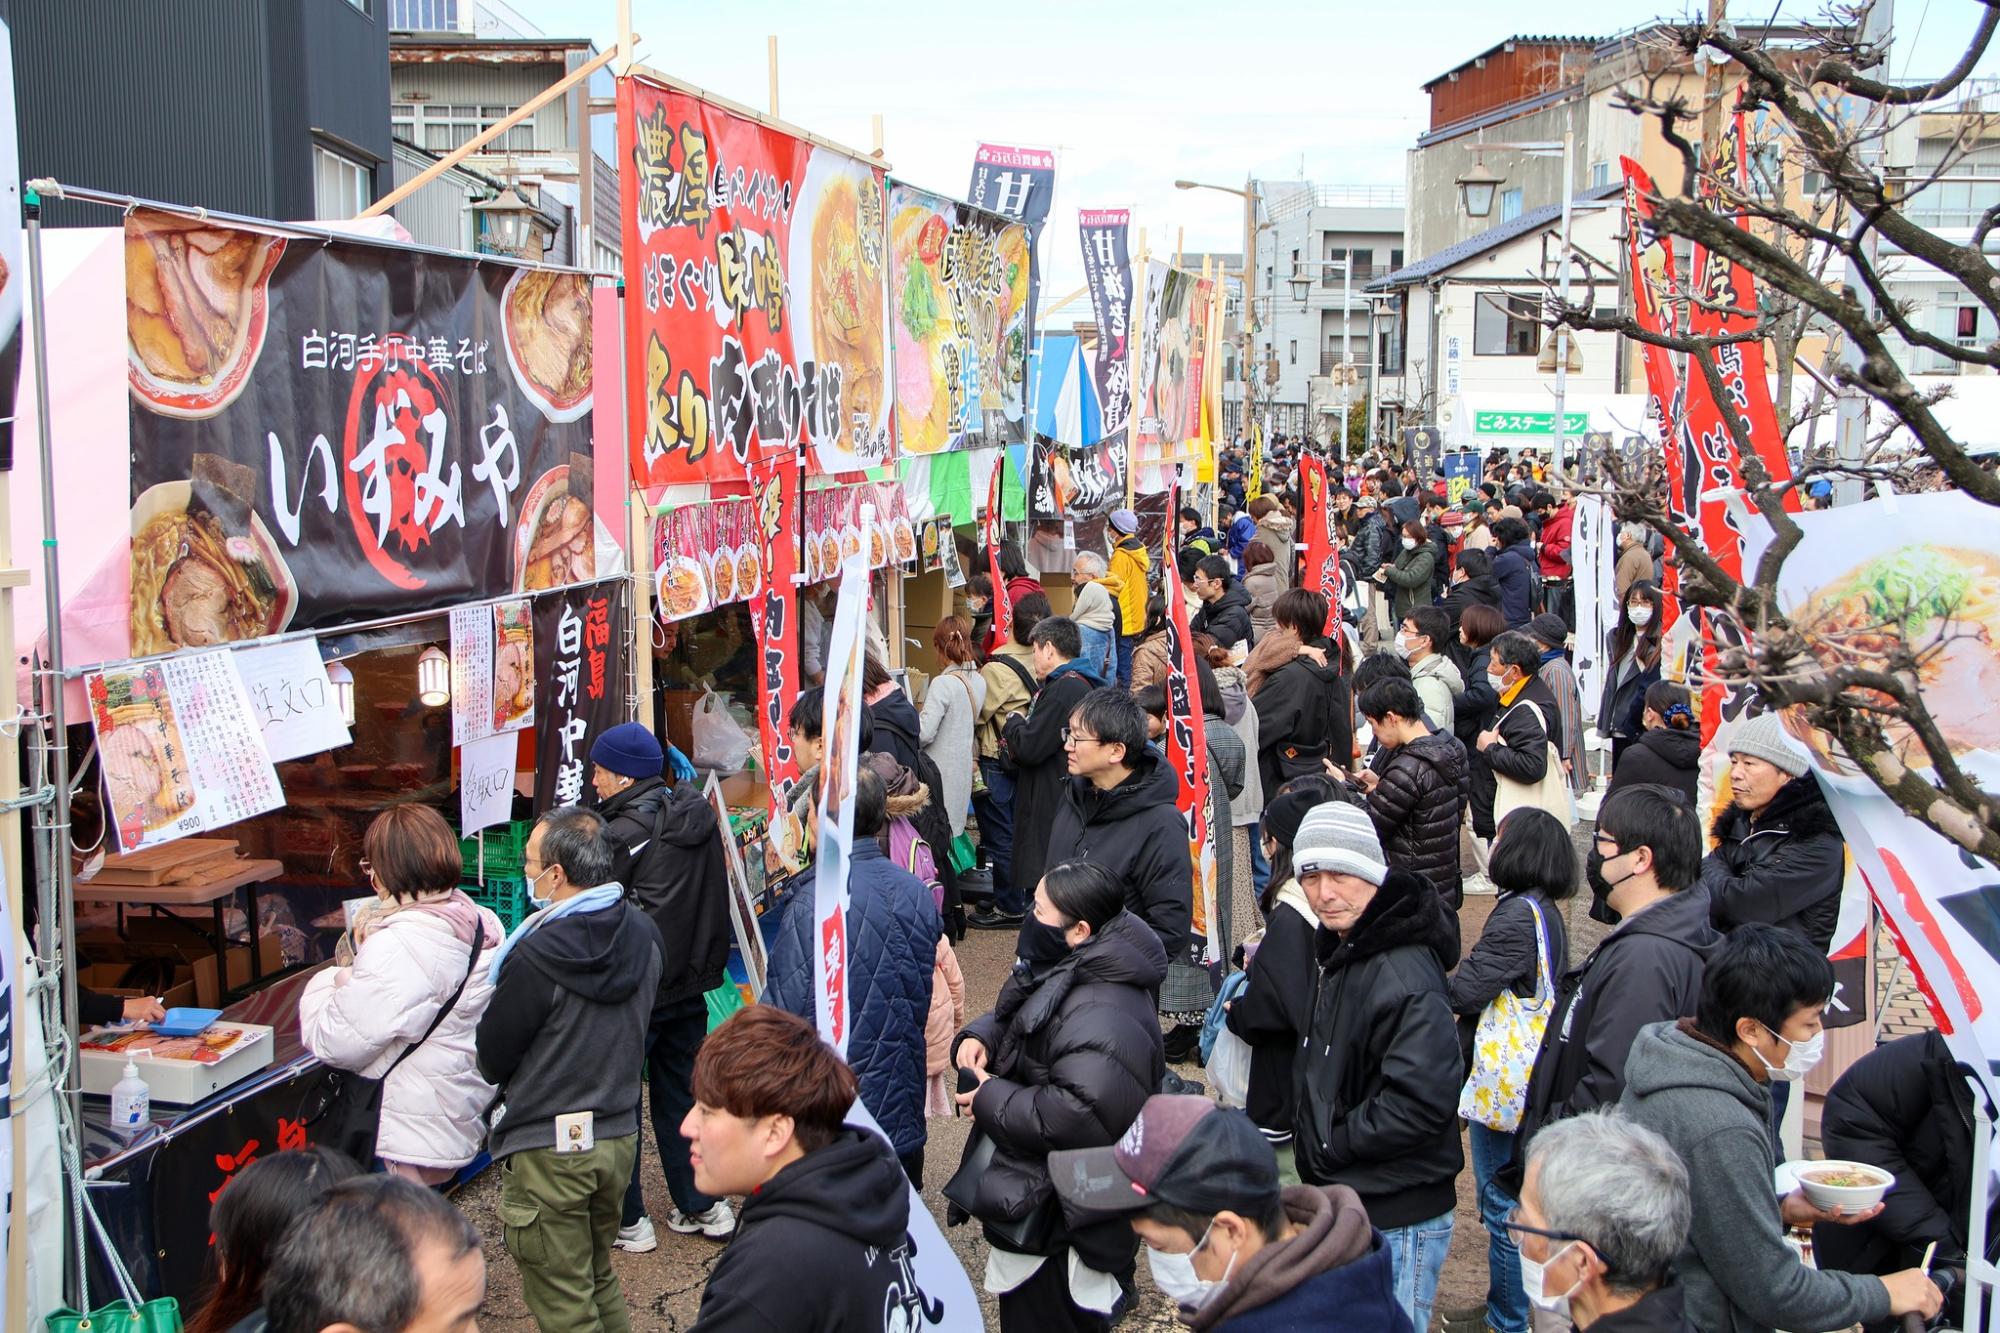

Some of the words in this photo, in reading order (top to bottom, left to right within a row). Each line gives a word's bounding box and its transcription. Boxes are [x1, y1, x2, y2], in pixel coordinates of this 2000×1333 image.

[302, 329, 488, 374] 白河手打中華そば
[268, 389, 522, 549] いずみや
[584, 598, 610, 700] 福島
[252, 678, 324, 731] 注文口
[465, 763, 508, 813] 受取口
[177, 815, 201, 832] ¥900
